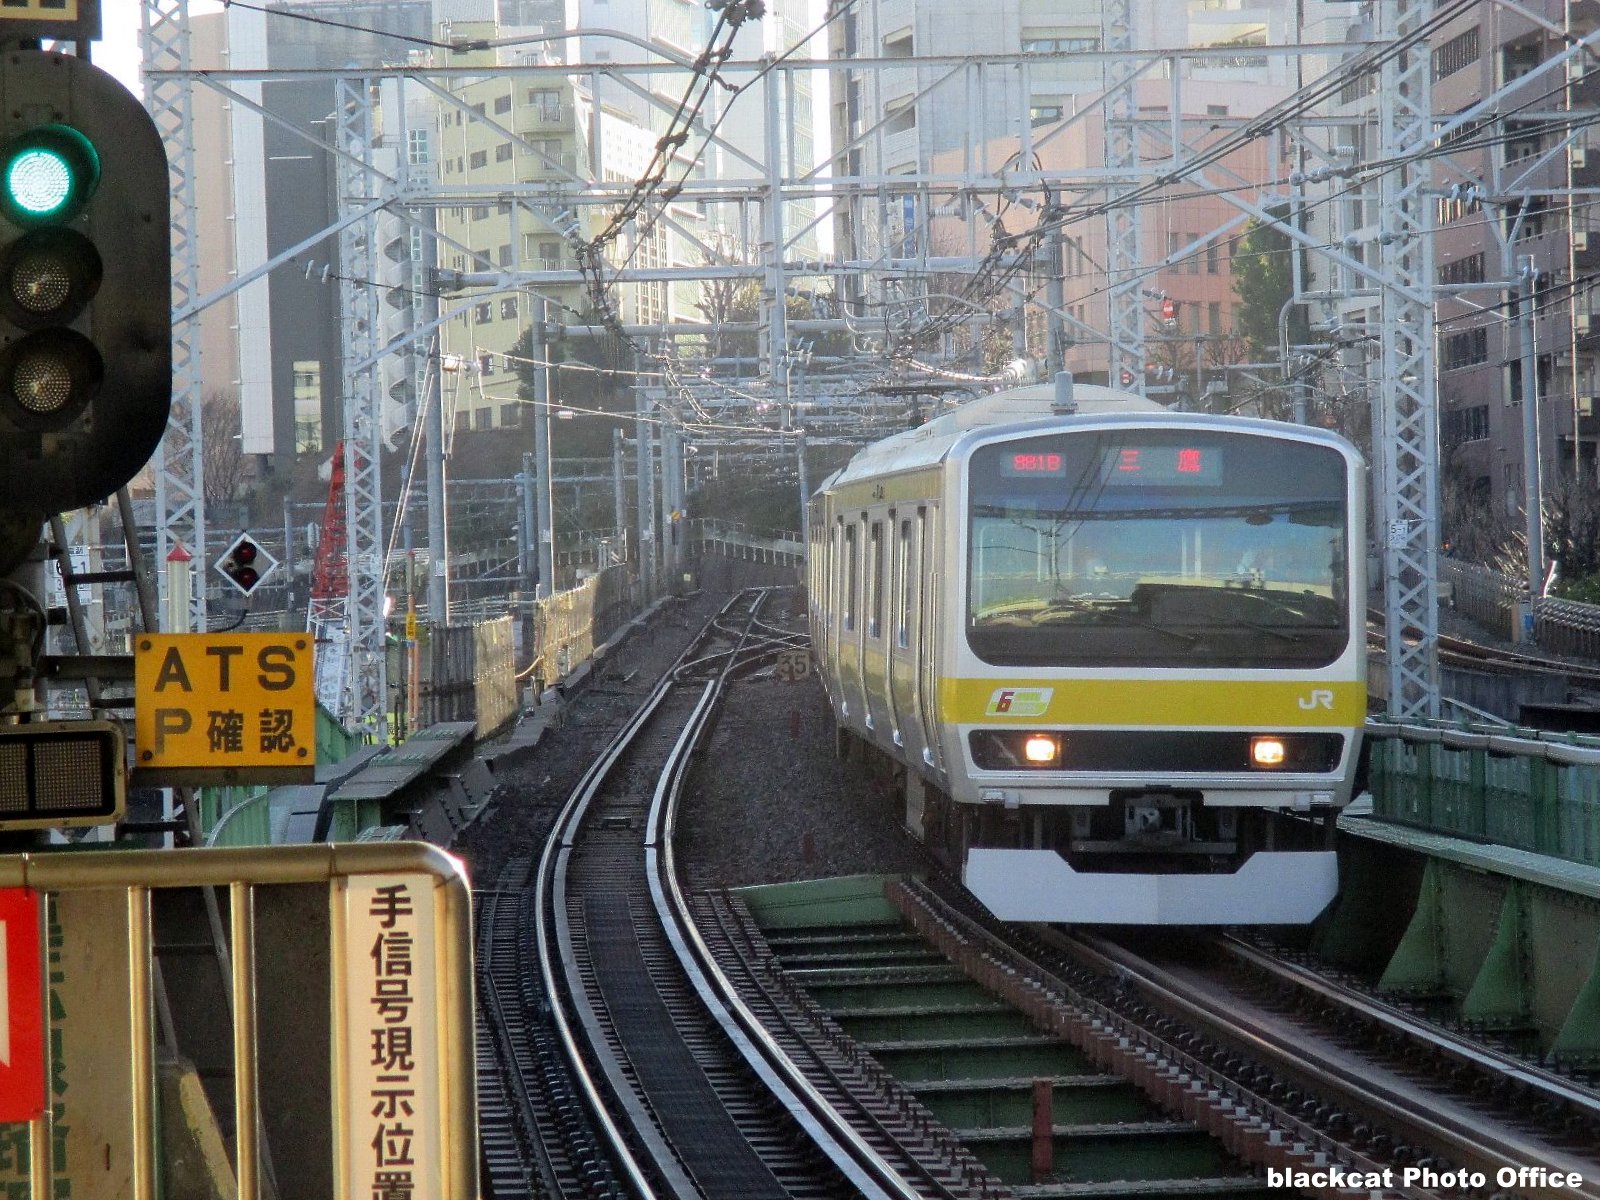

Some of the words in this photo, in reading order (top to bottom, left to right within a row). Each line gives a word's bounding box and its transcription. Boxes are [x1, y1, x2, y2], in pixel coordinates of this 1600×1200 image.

[154, 645, 296, 692] ATS
[781, 654, 807, 674] 35
[1299, 689, 1333, 709] JR
[369, 884, 415, 1200] 手信号現示位置
